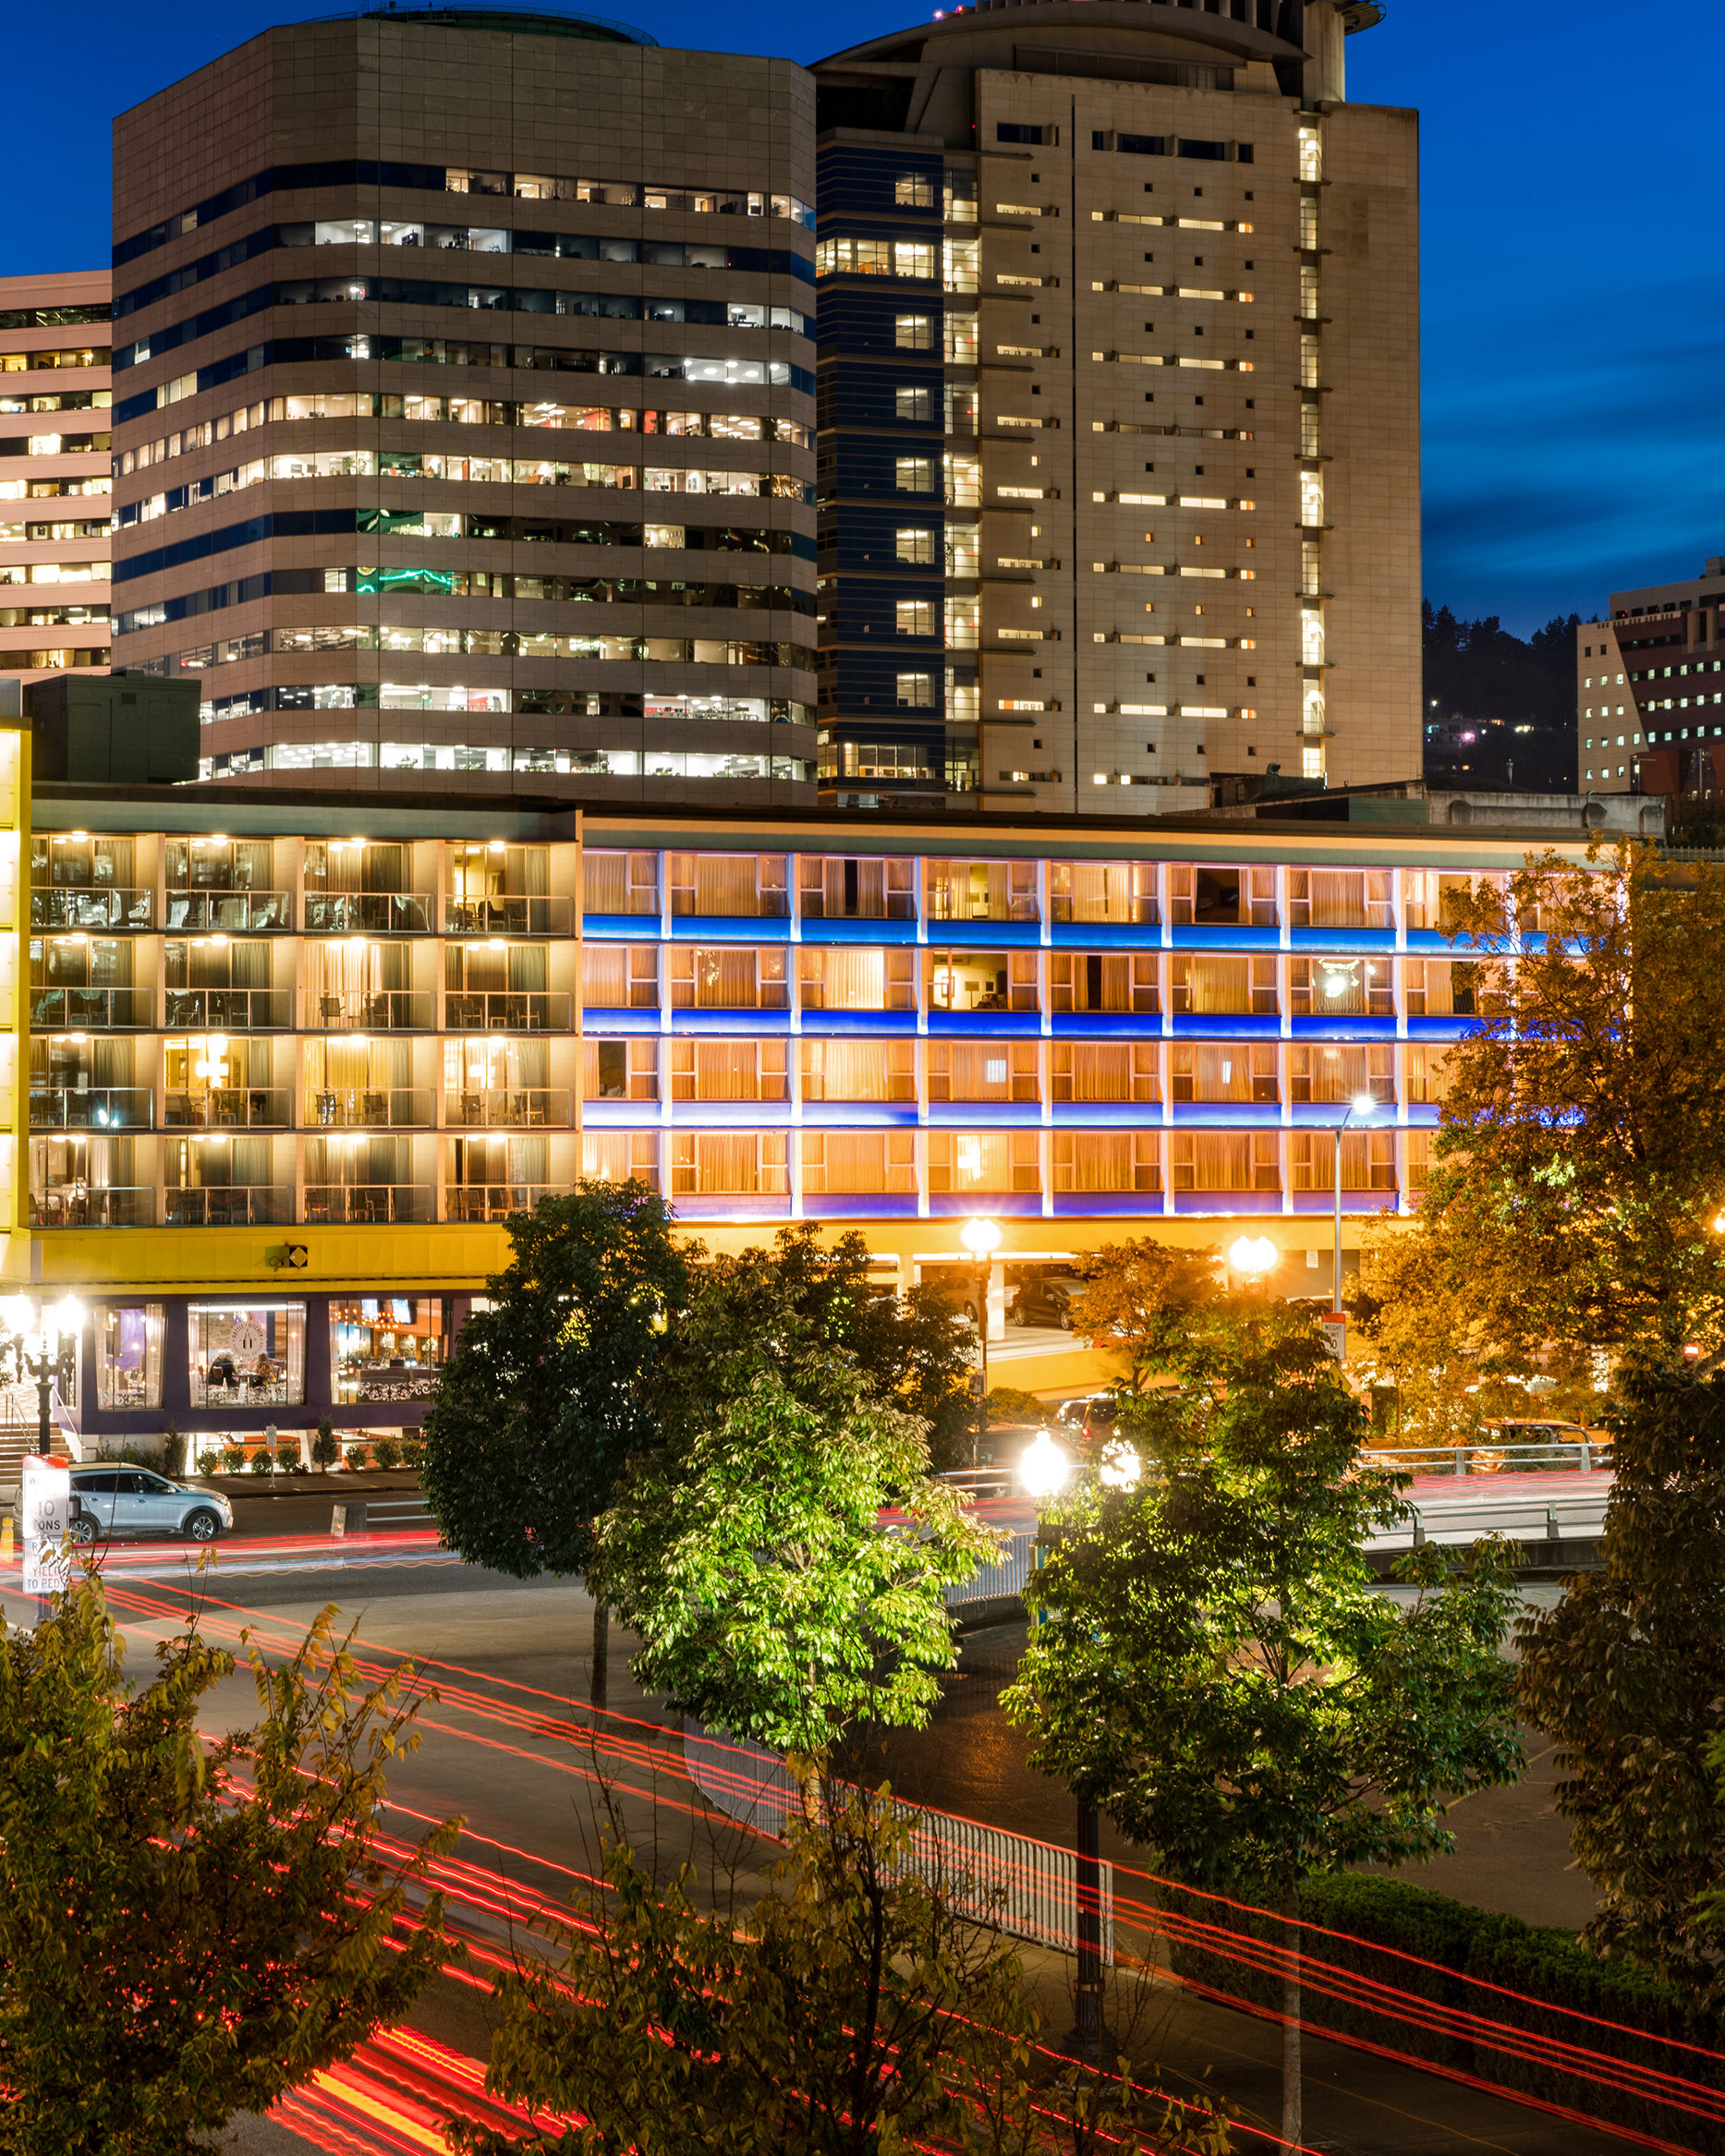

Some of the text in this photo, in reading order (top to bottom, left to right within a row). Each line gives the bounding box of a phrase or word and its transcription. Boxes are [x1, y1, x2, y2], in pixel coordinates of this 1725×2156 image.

[38, 1500, 55, 1517] 10
[32, 1520, 61, 1531] TONS
[32, 1567, 60, 1577] YIELD
[27, 1579, 38, 1589] TO
